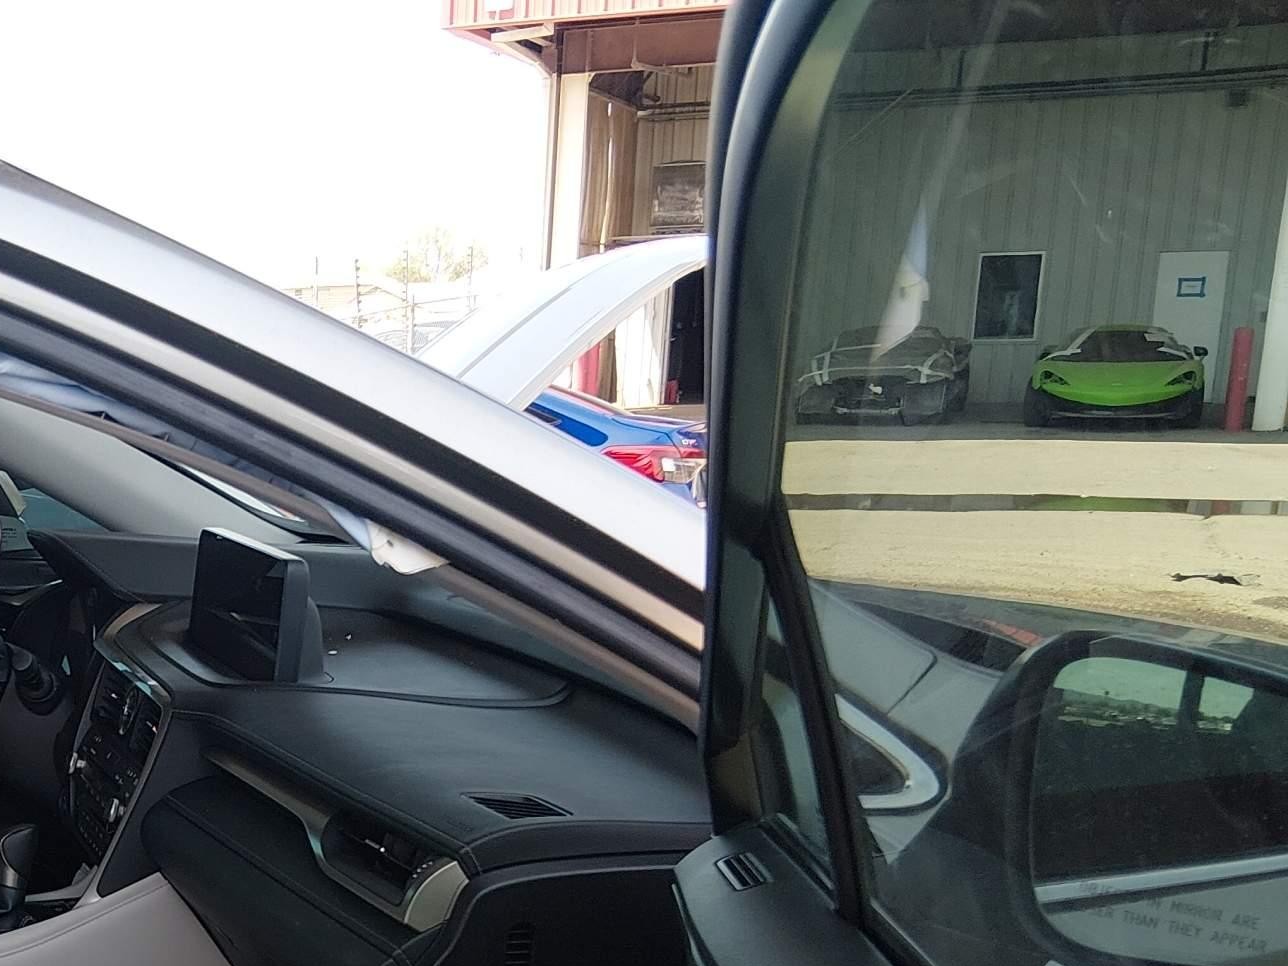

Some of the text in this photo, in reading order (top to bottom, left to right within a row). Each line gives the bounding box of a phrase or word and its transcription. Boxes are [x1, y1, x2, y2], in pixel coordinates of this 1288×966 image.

[1123, 909, 1268, 952] THAN THEY APPEAR
[1169, 900, 1224, 921] MIRROR
[1231, 913, 1262, 931] ARE
